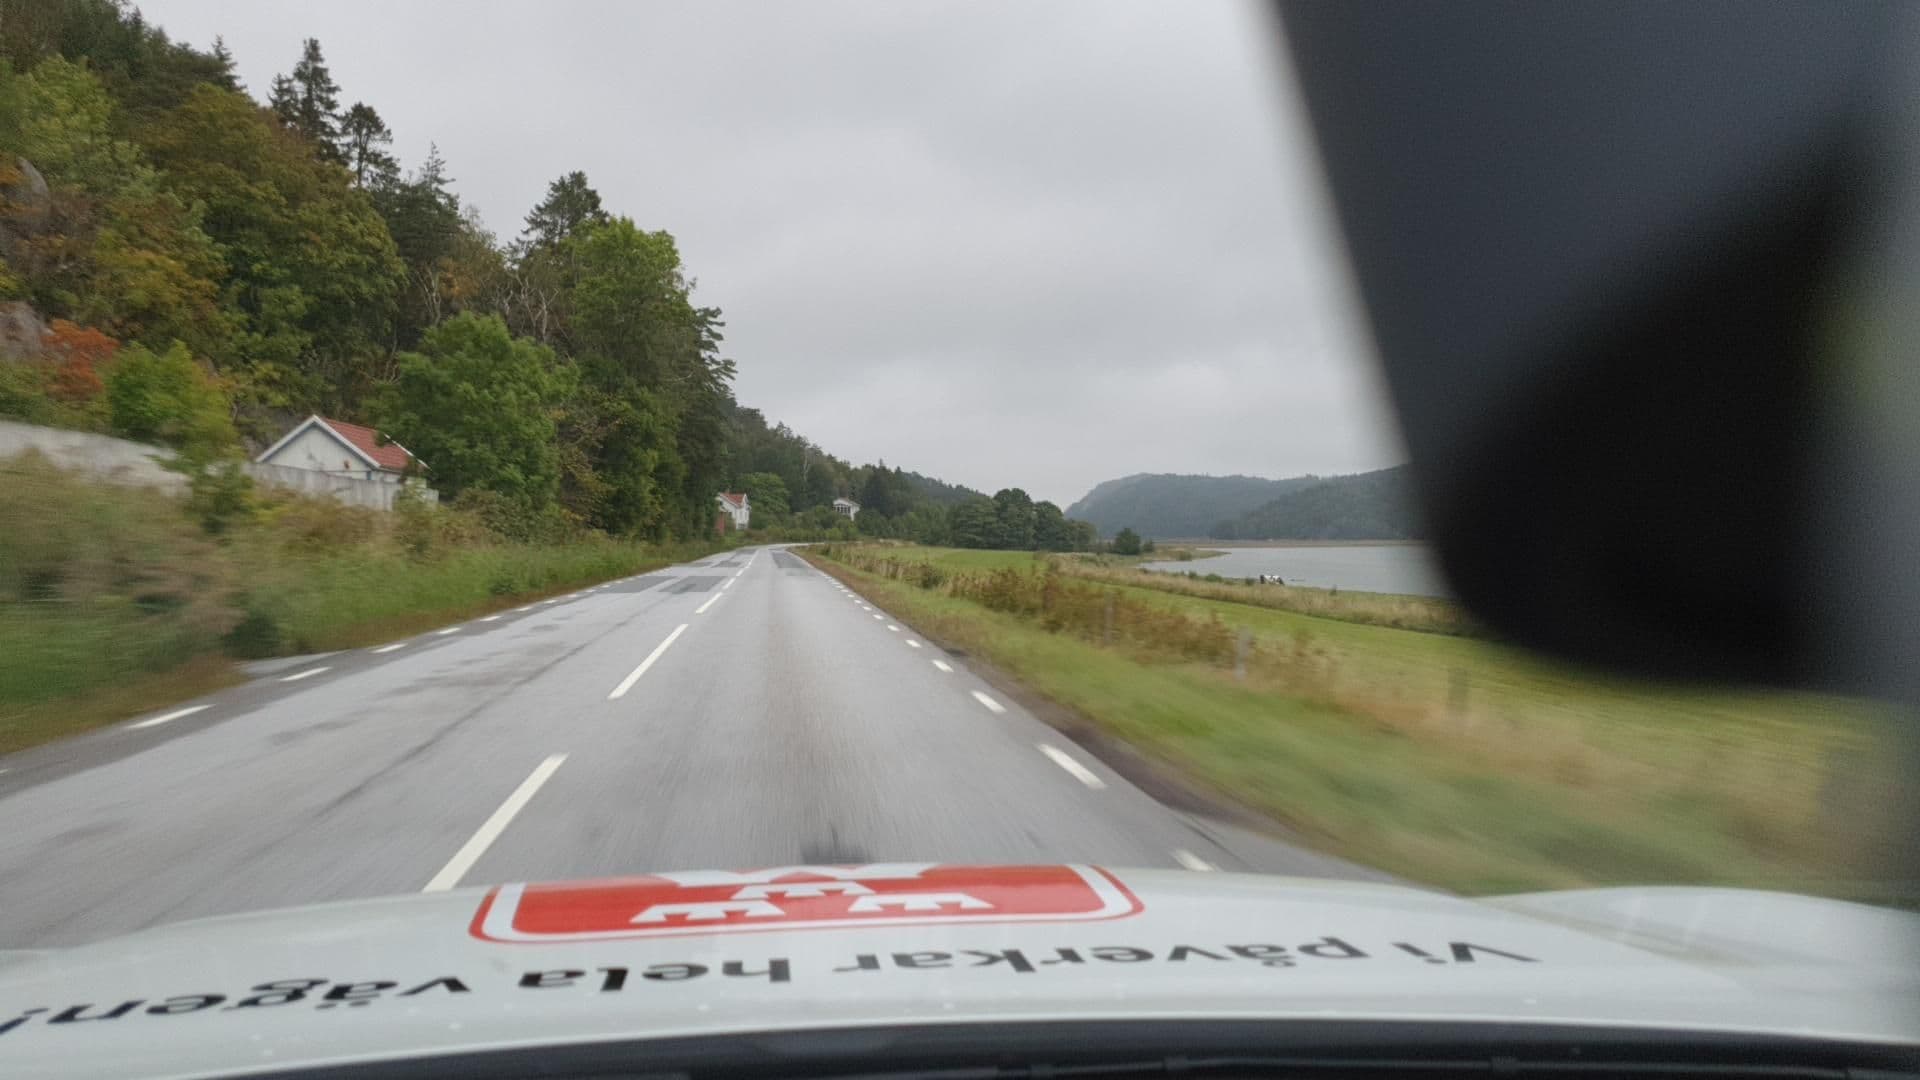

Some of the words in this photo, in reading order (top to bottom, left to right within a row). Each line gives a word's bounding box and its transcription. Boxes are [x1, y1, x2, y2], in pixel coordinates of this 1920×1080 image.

[834, 936, 1371, 973] påverkar
[1391, 940, 1541, 965] Vi
[518, 958, 791, 992] hela
